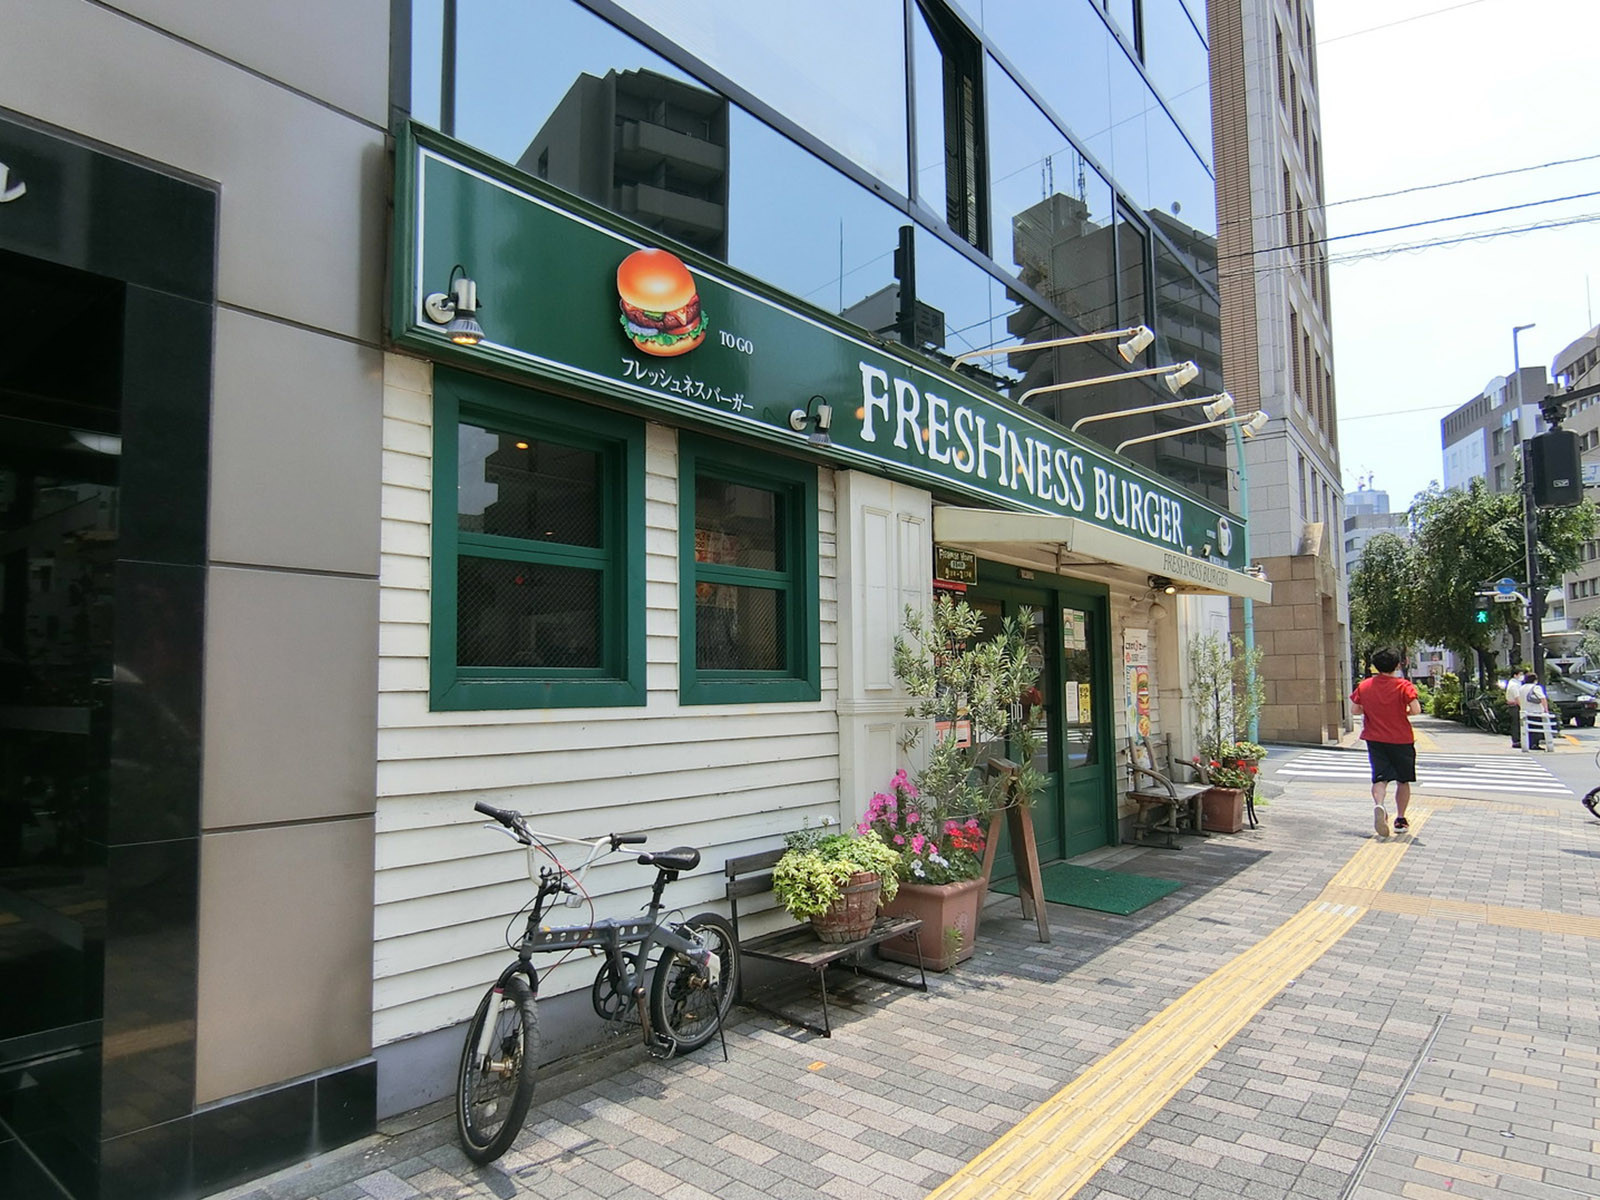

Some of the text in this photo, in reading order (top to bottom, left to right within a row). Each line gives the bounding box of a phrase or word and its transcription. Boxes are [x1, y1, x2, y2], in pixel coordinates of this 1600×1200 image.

[719, 330, 754, 355] TO GO
[621, 357, 754, 412] フレッシュネスバーガー
[858, 361, 1185, 549] FRESHNESS BURGER
[1163, 553, 1203, 580] FRESHNESS
[1203, 565, 1229, 587] BURGER
